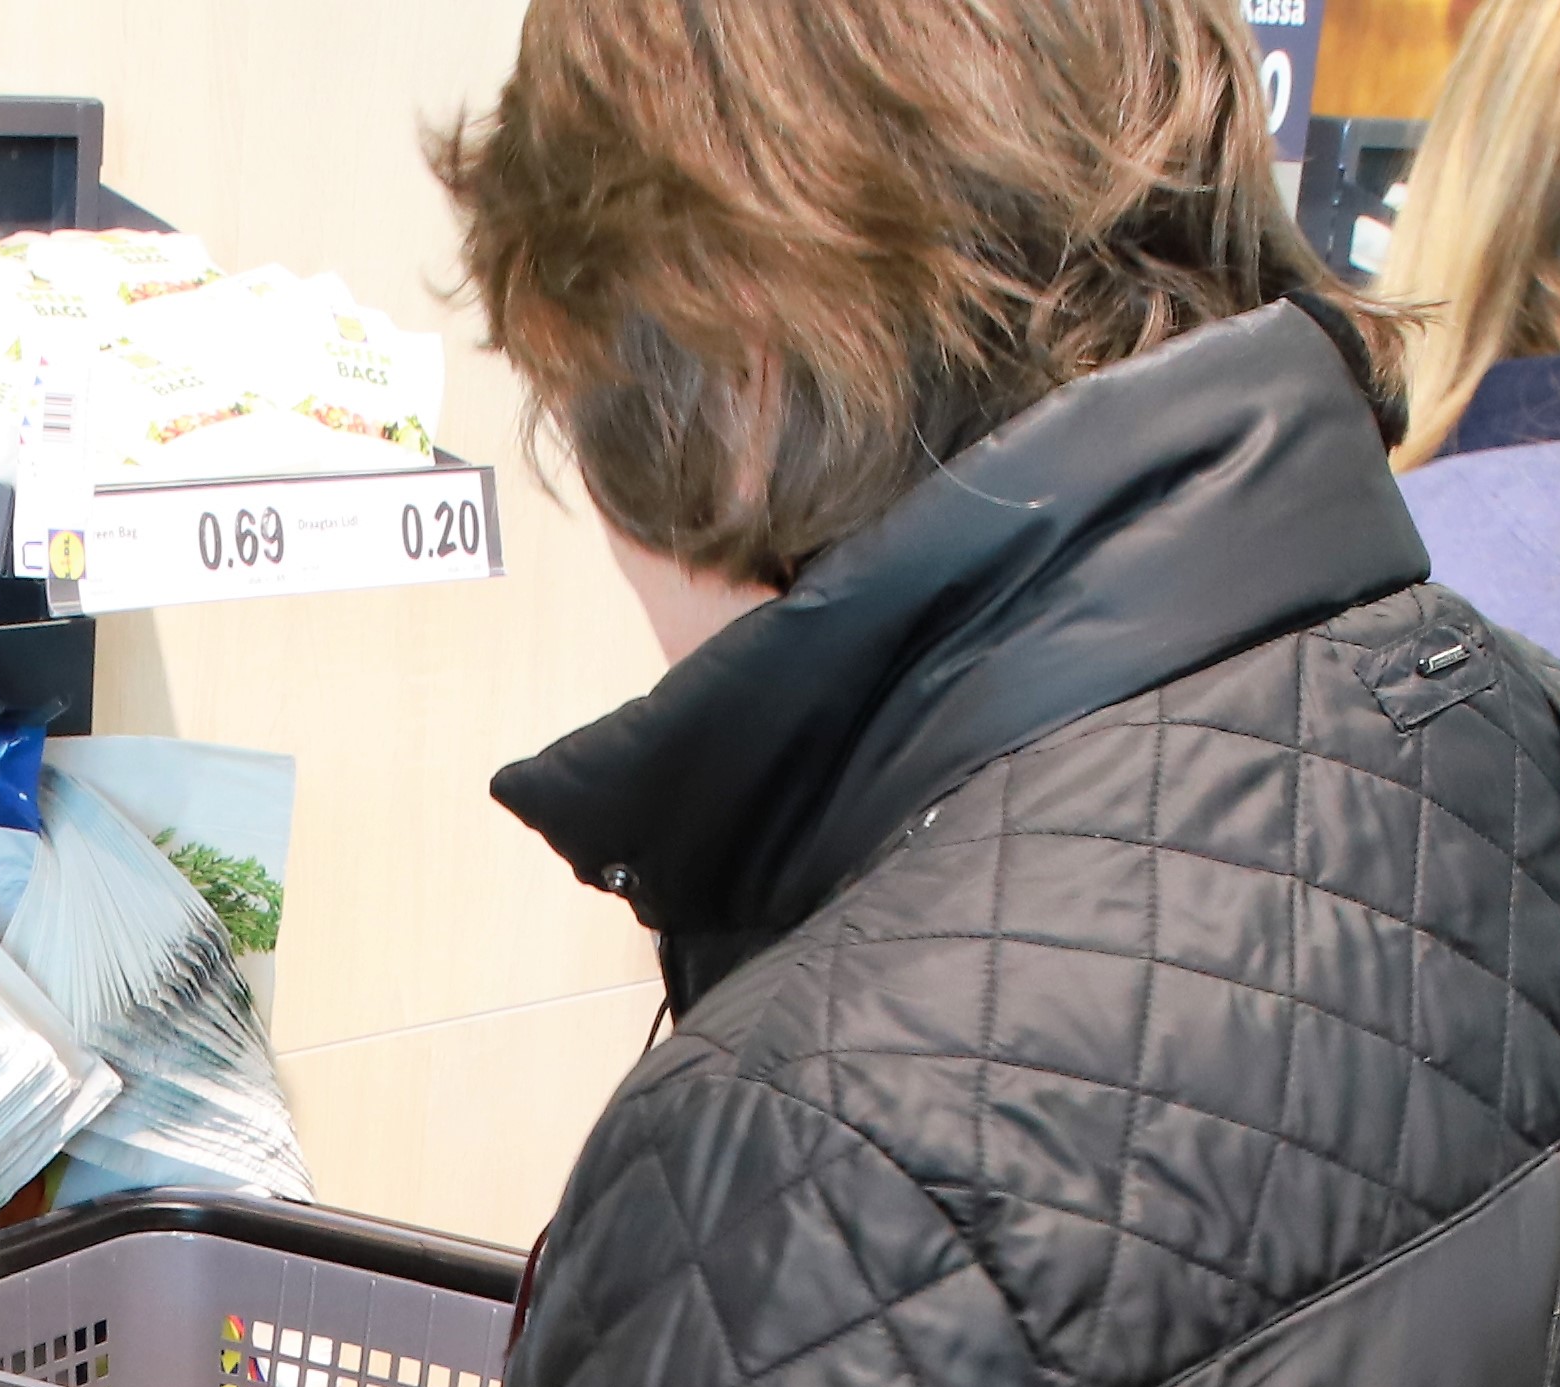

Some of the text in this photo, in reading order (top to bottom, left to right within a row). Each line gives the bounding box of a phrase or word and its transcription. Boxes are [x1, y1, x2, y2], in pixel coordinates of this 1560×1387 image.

[337, 361, 389, 386] BAGS
[118, 525, 138, 539] Bag
[198, 507, 284, 571] 0.69
[401, 500, 480, 560] 0.20
